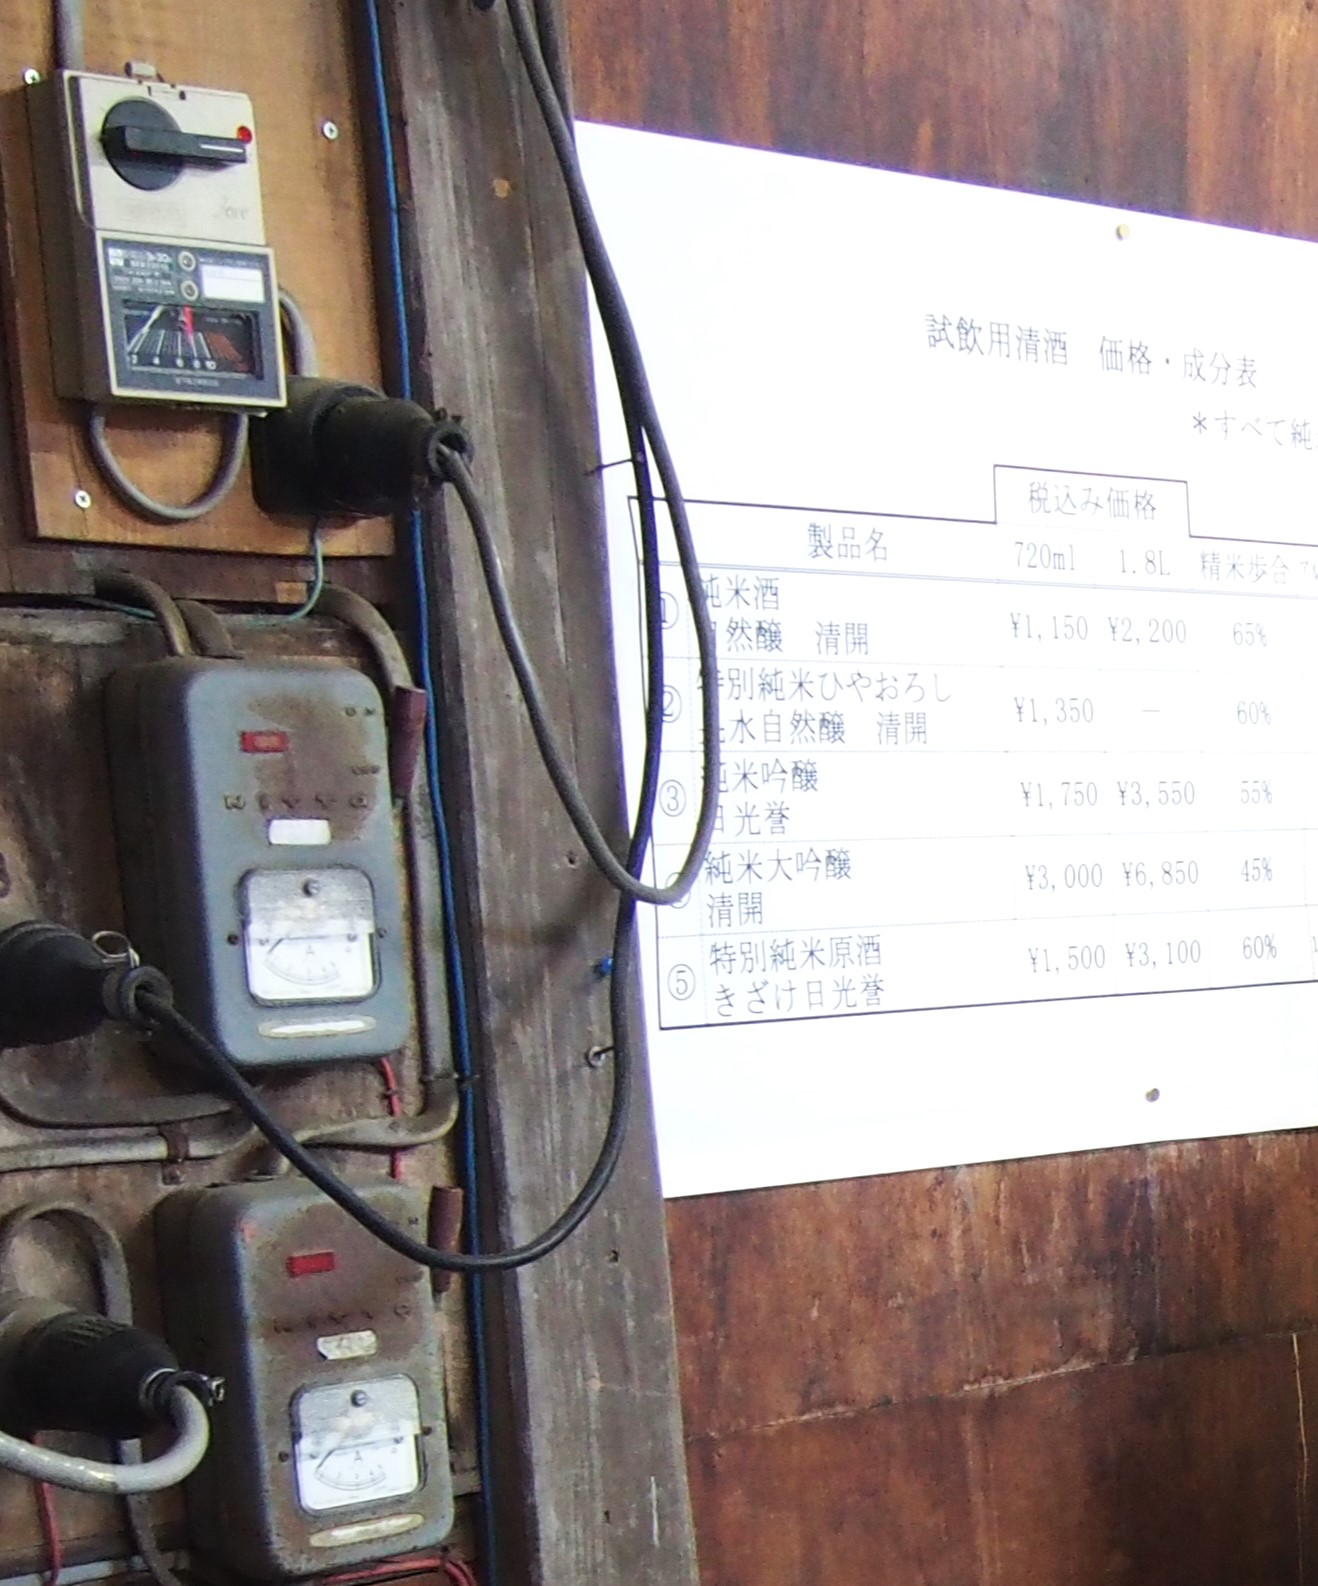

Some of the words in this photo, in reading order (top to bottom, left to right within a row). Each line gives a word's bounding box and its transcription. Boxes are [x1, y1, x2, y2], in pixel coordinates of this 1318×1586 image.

[924, 313, 1068, 365] 試飲用清酒
[1099, 335, 1257, 389] 価格・成分表
[1028, 480, 1157, 520] 税込み価格
[807, 523, 890, 563] 製品名
[1014, 541, 1078, 571] 720ml
[1119, 548, 1171, 577] 1.8L
[1199, 548, 1289, 585] 精米歩合
[1009, 611, 1089, 643] ¥1,150
[1107, 615, 1187, 646] ¥2,200
[1232, 620, 1268, 648] 65%
[1013, 696, 1095, 727] ¥1,350
[1236, 700, 1272, 726] 60%
[1019, 780, 1098, 810] ¥1,750
[1116, 779, 1196, 809] ¥3,550
[1240, 778, 1273, 805] 55%
[704, 846, 852, 885] 純米大吟醸
[1024, 862, 1103, 893] ¥3,000
[1121, 859, 1199, 890] ¥6,850
[1240, 855, 1273, 883] 45%
[708, 891, 764, 929] 清開
[708, 933, 883, 977] 特別純米原酒
[1027, 943, 1106, 975] ¥1,500
[1124, 939, 1202, 970] ¥3,100
[1241, 931, 1278, 960] 60%
[712, 972, 885, 1018] きざけ日光誉
